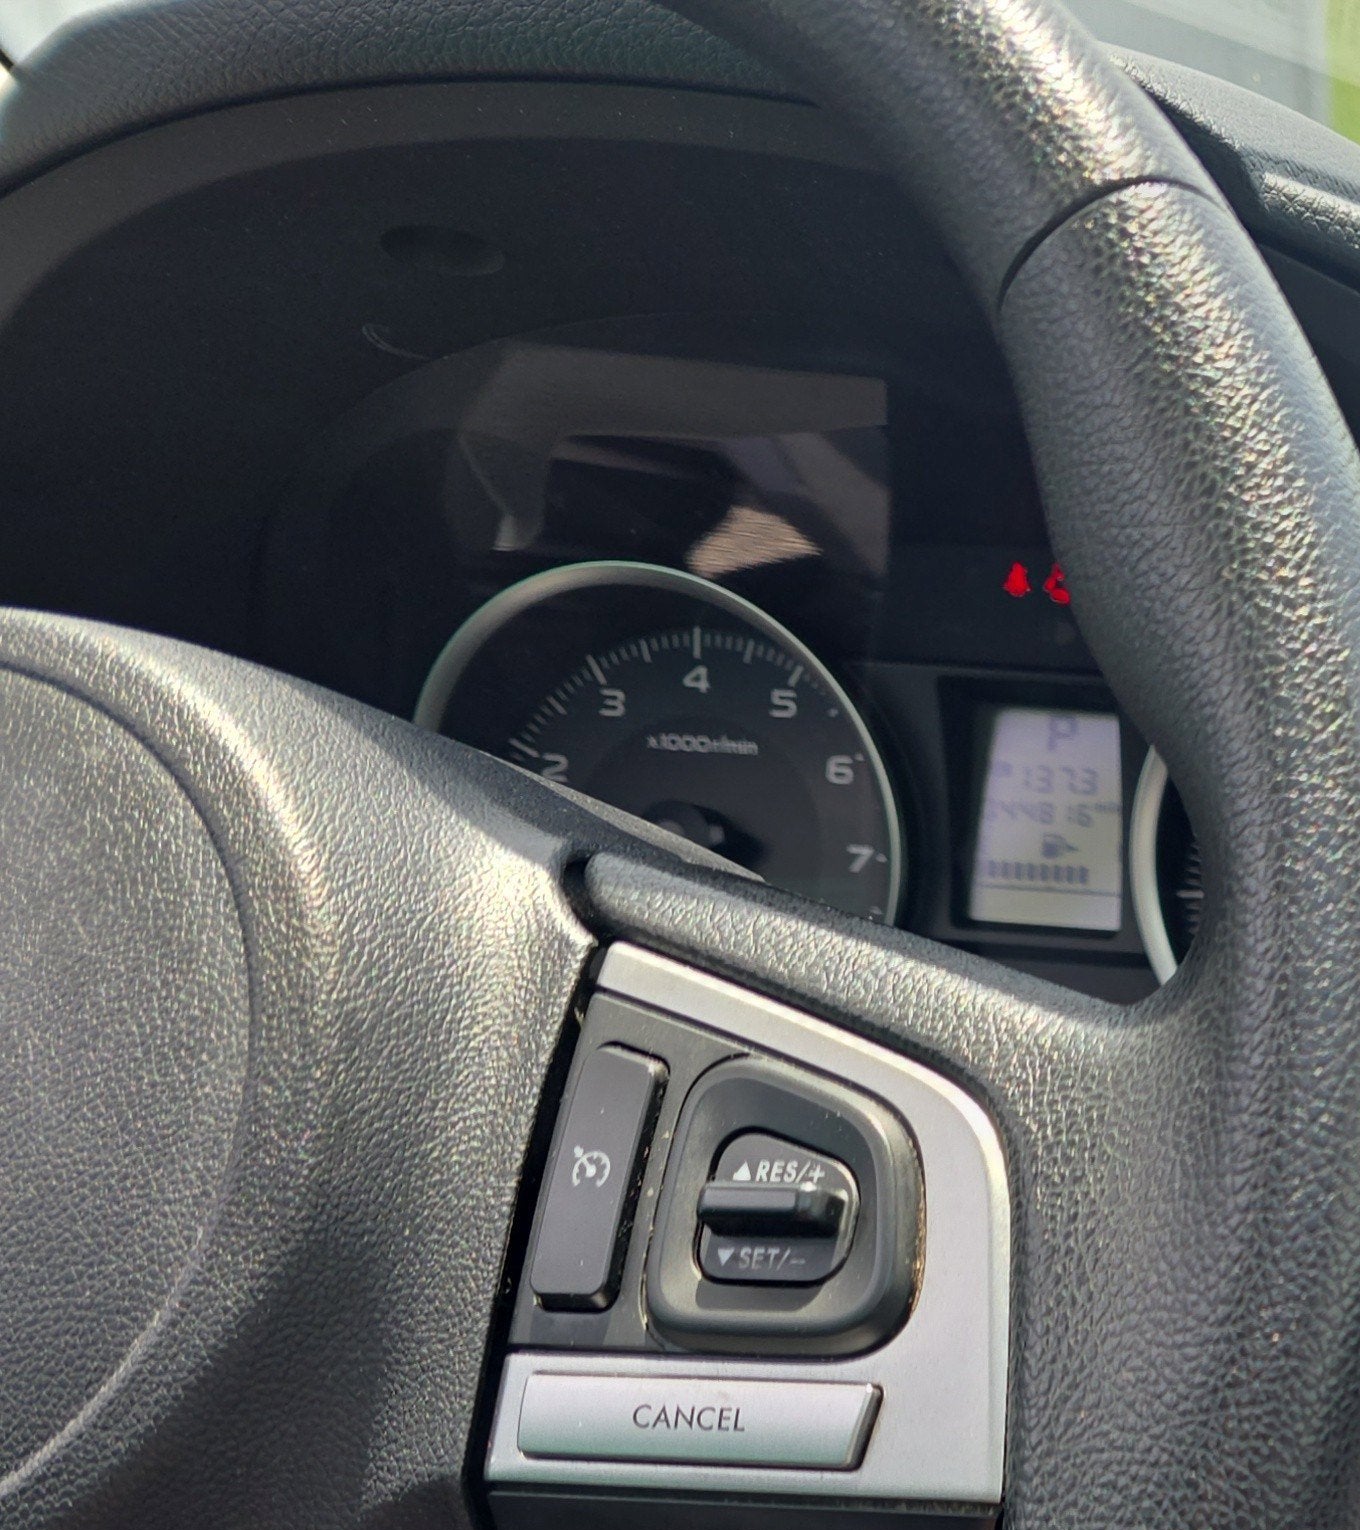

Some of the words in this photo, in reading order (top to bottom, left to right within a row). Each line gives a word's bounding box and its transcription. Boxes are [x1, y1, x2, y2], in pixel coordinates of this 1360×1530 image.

[683, 666, 710, 693] 4
[600, 688, 626, 717] 3
[769, 689, 797, 719] 5
[1048, 715, 1077, 751] P
[542, 754, 568, 783] 2
[825, 755, 854, 784] 6
[847, 845, 874, 873] 7
[632, 1404, 745, 1432] CANCEL
